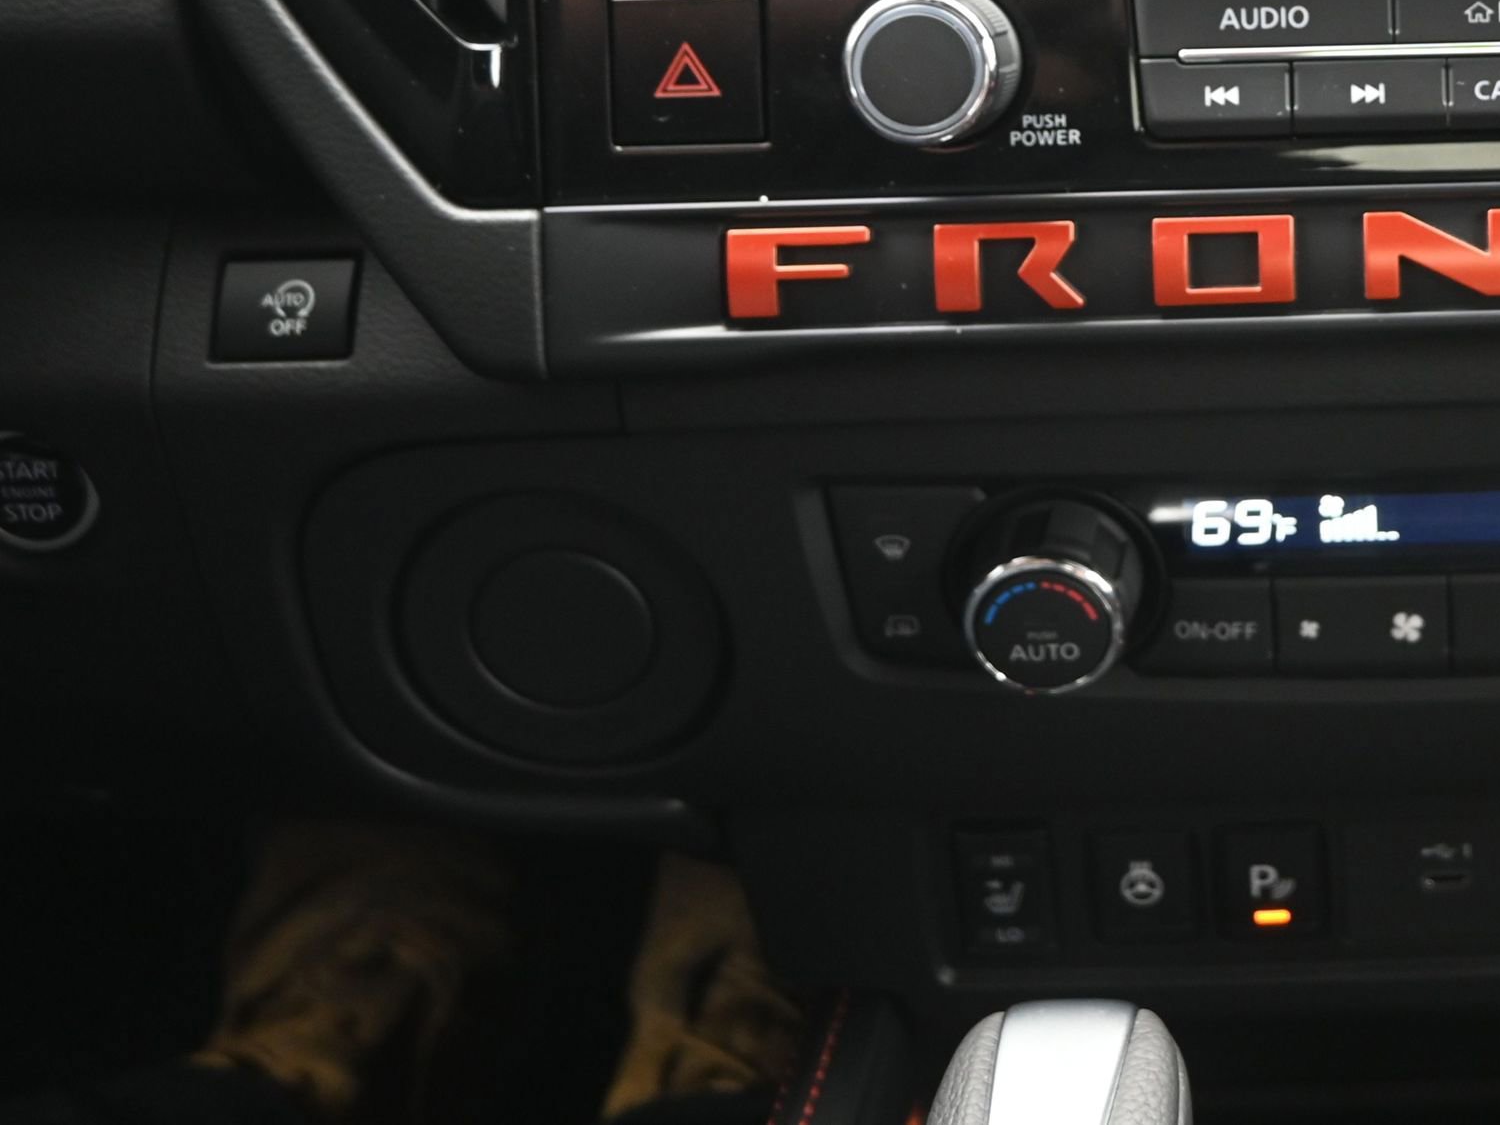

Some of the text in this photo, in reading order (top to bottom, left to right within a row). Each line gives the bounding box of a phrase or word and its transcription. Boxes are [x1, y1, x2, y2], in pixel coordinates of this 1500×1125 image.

[1219, 6, 1310, 31] AUDIO
[1022, 114, 1067, 129] PUSH
[1009, 128, 1082, 146] POWER
[261, 291, 304, 308] AUTO
[268, 319, 306, 337] OFF
[3, 502, 63, 523] STOP
[1008, 641, 1082, 663] AUTO
